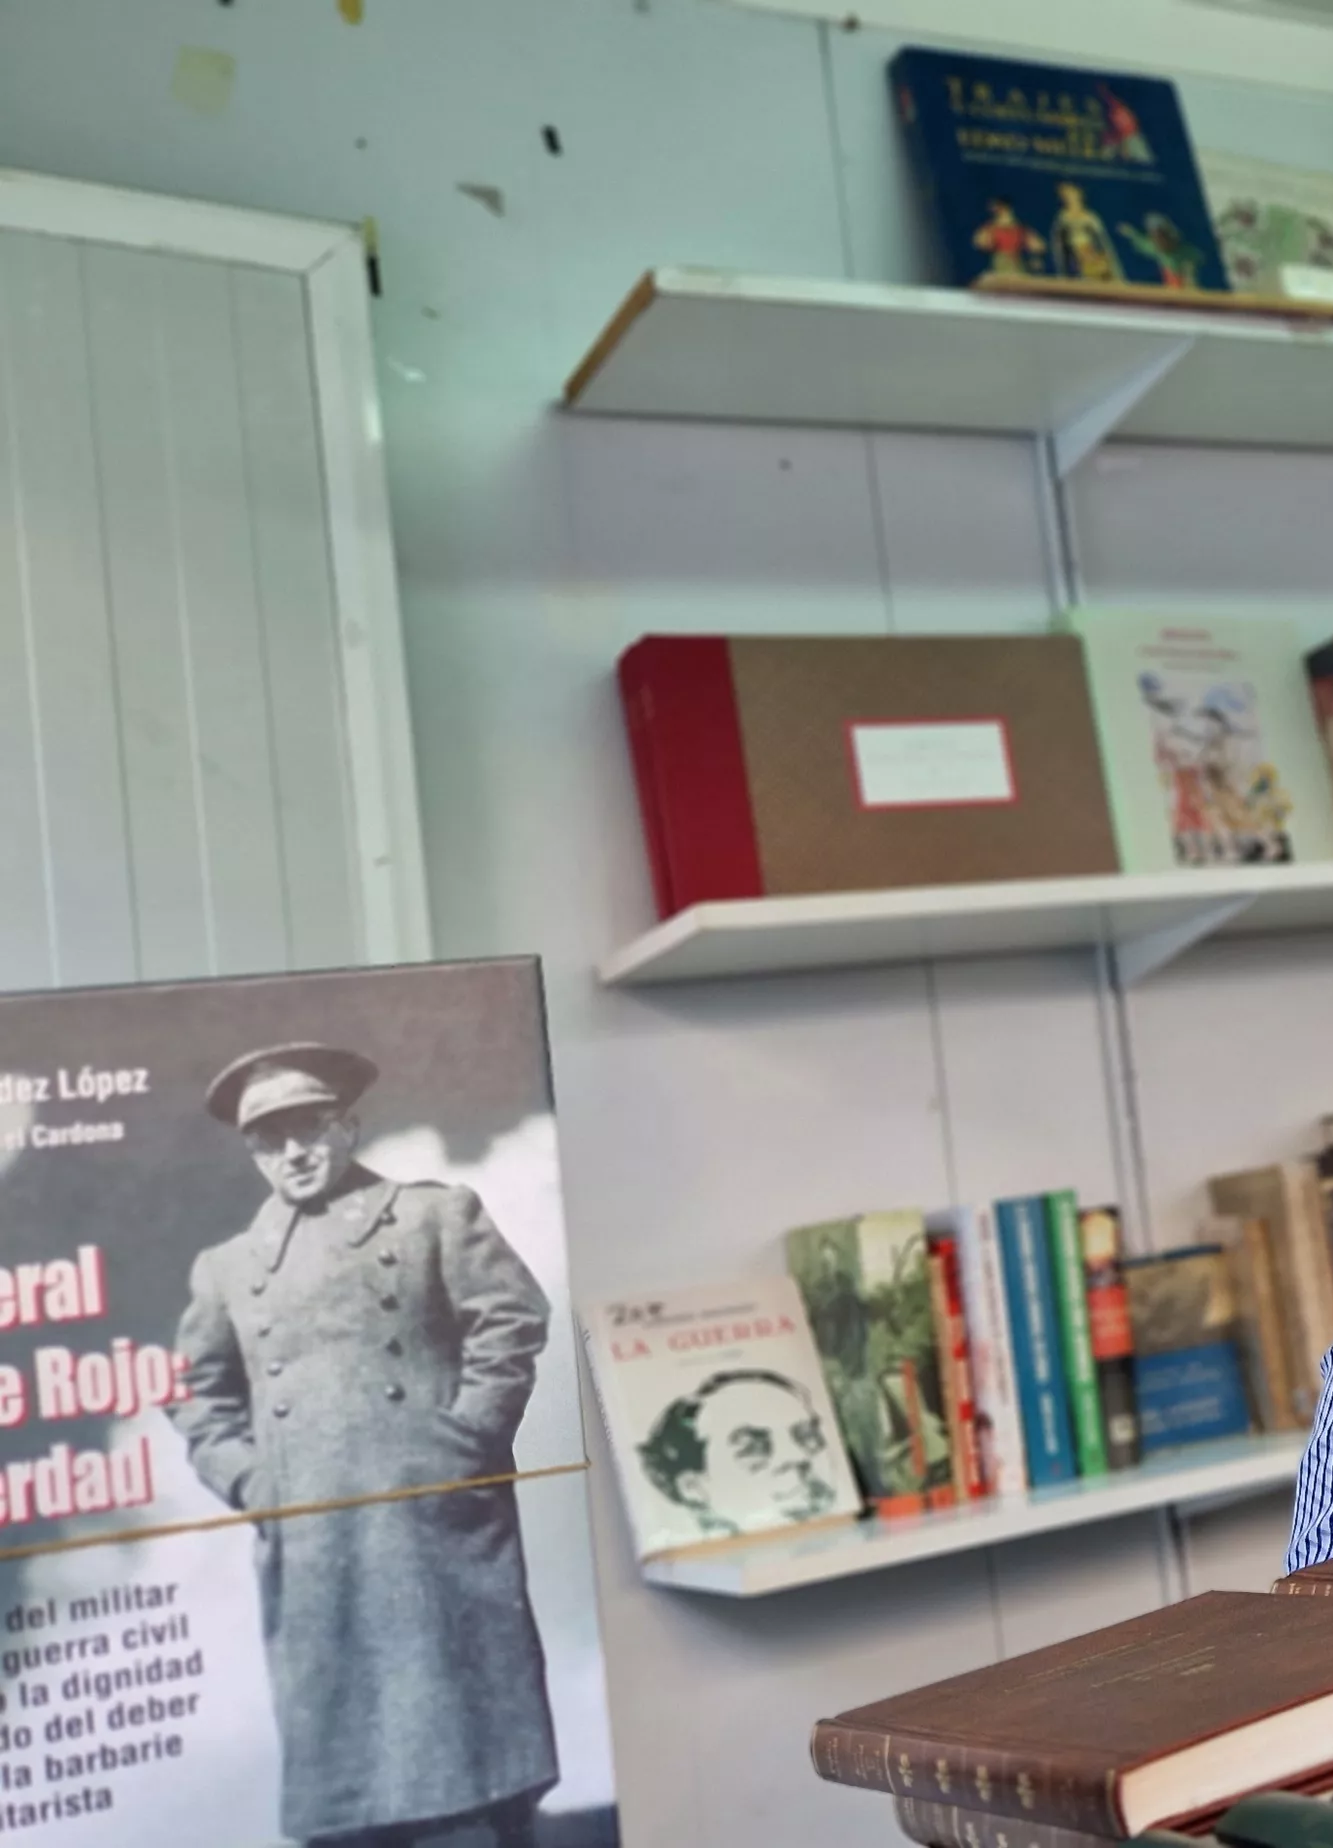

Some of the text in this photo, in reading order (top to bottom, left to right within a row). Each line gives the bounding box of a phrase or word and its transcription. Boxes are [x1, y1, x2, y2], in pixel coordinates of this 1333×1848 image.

[58, 1065, 150, 1103] López
[32, 1121, 125, 1148] Cardona
[667, 1314, 796, 1353] GUERRA
[34, 1337, 196, 1420] Rojo:
[0, 1437, 154, 1530] rdad
[6, 1583, 179, 1633] del militar
[3, 1614, 189, 1678] guerra civil
[19, 1682, 50, 1709] la
[62, 1650, 204, 1700] dignidad
[45, 1708, 95, 1743] del
[106, 1693, 200, 1731] deber
[1, 1733, 183, 1792] la barbarie
